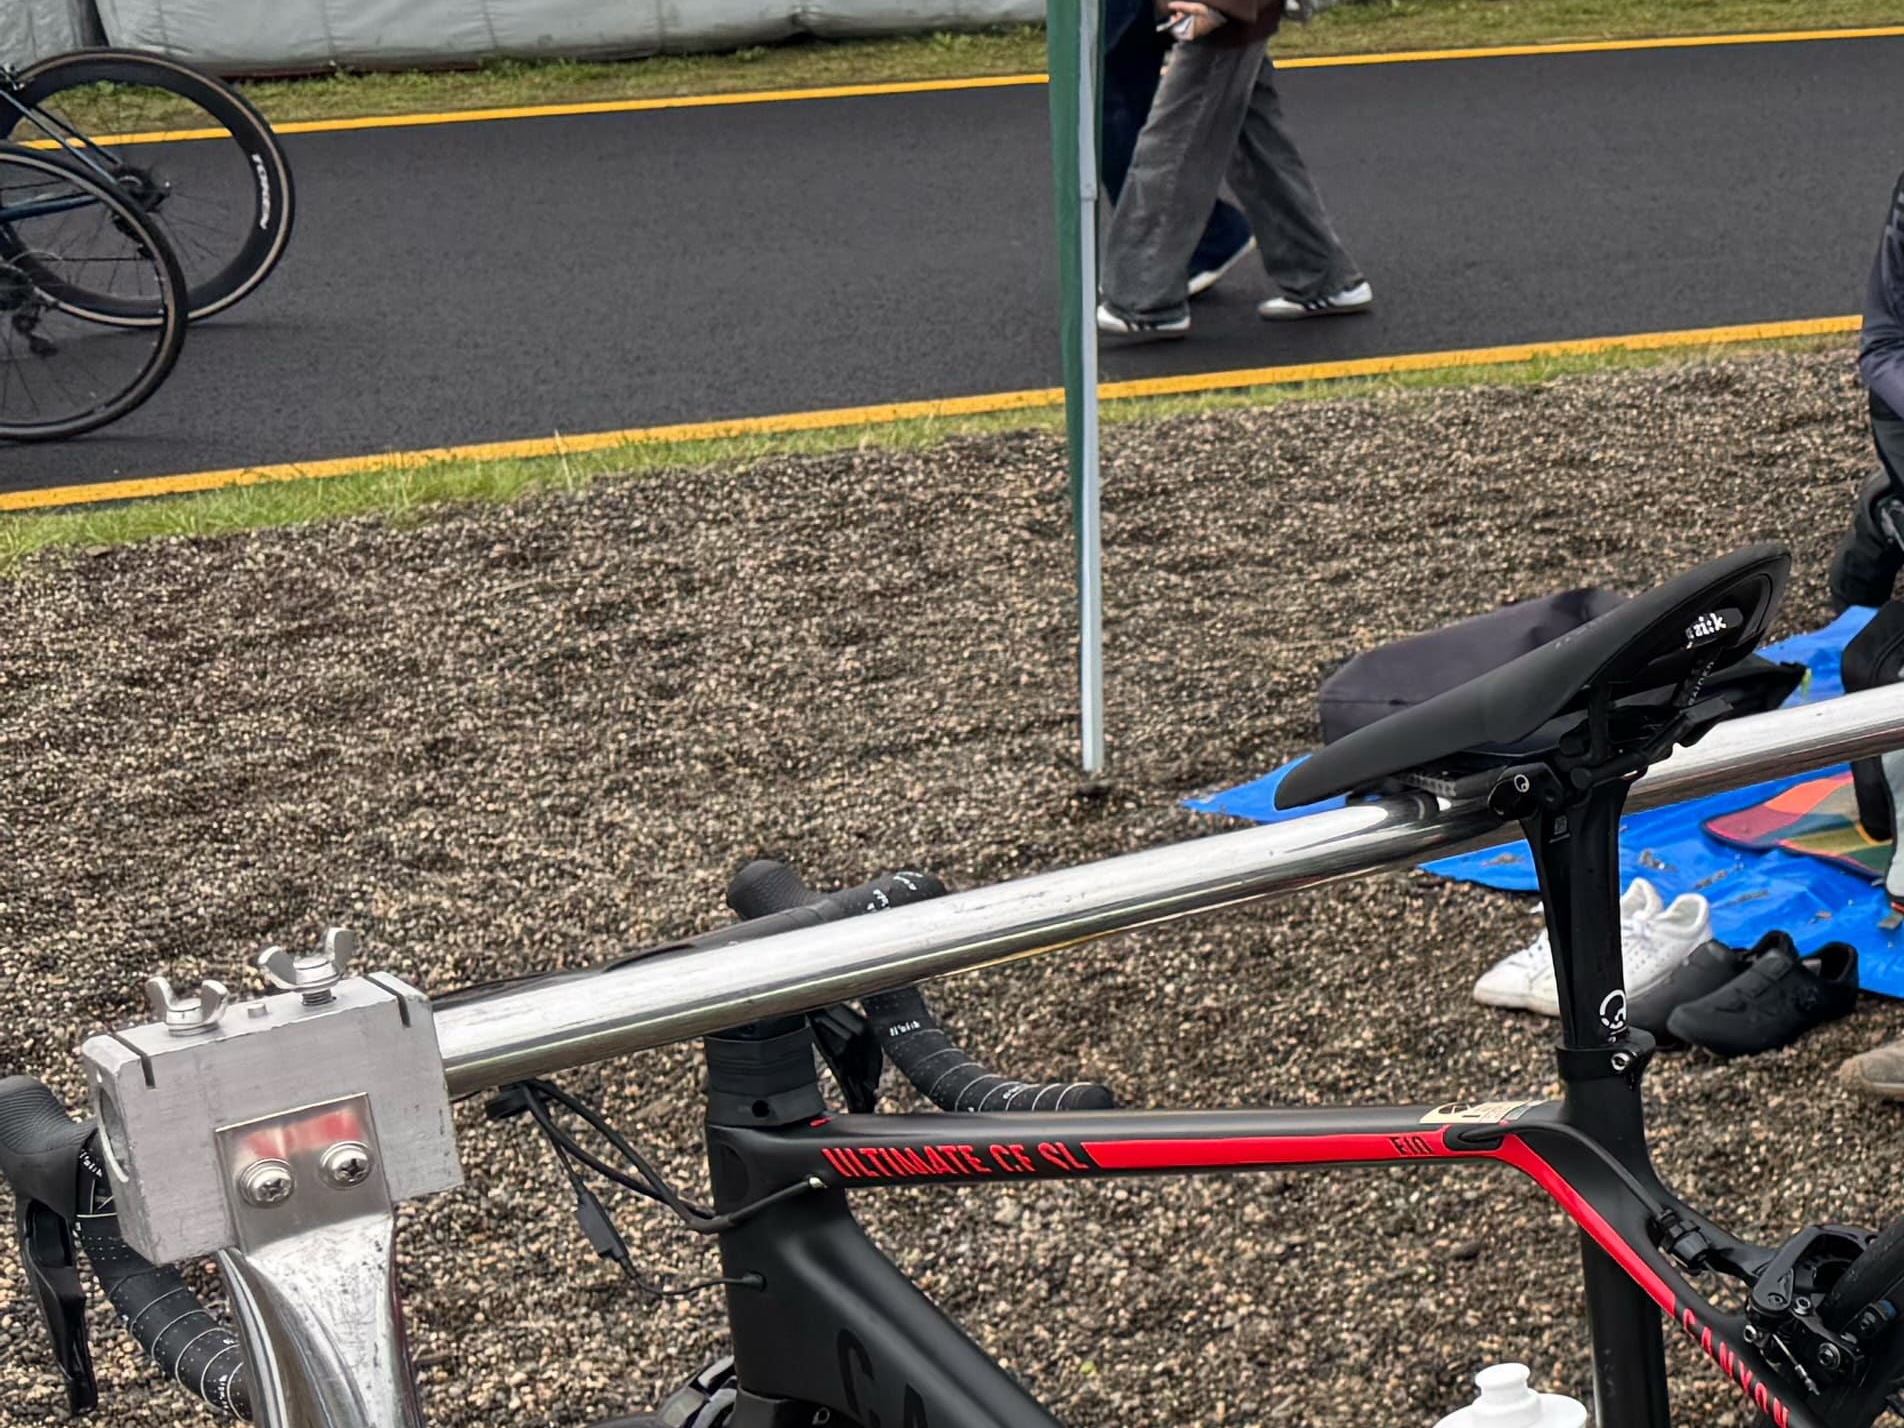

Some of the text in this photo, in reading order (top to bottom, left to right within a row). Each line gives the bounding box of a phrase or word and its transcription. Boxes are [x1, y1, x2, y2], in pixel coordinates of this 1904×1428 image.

[822, 1141, 1089, 1177] ULTIMATE CF SL
